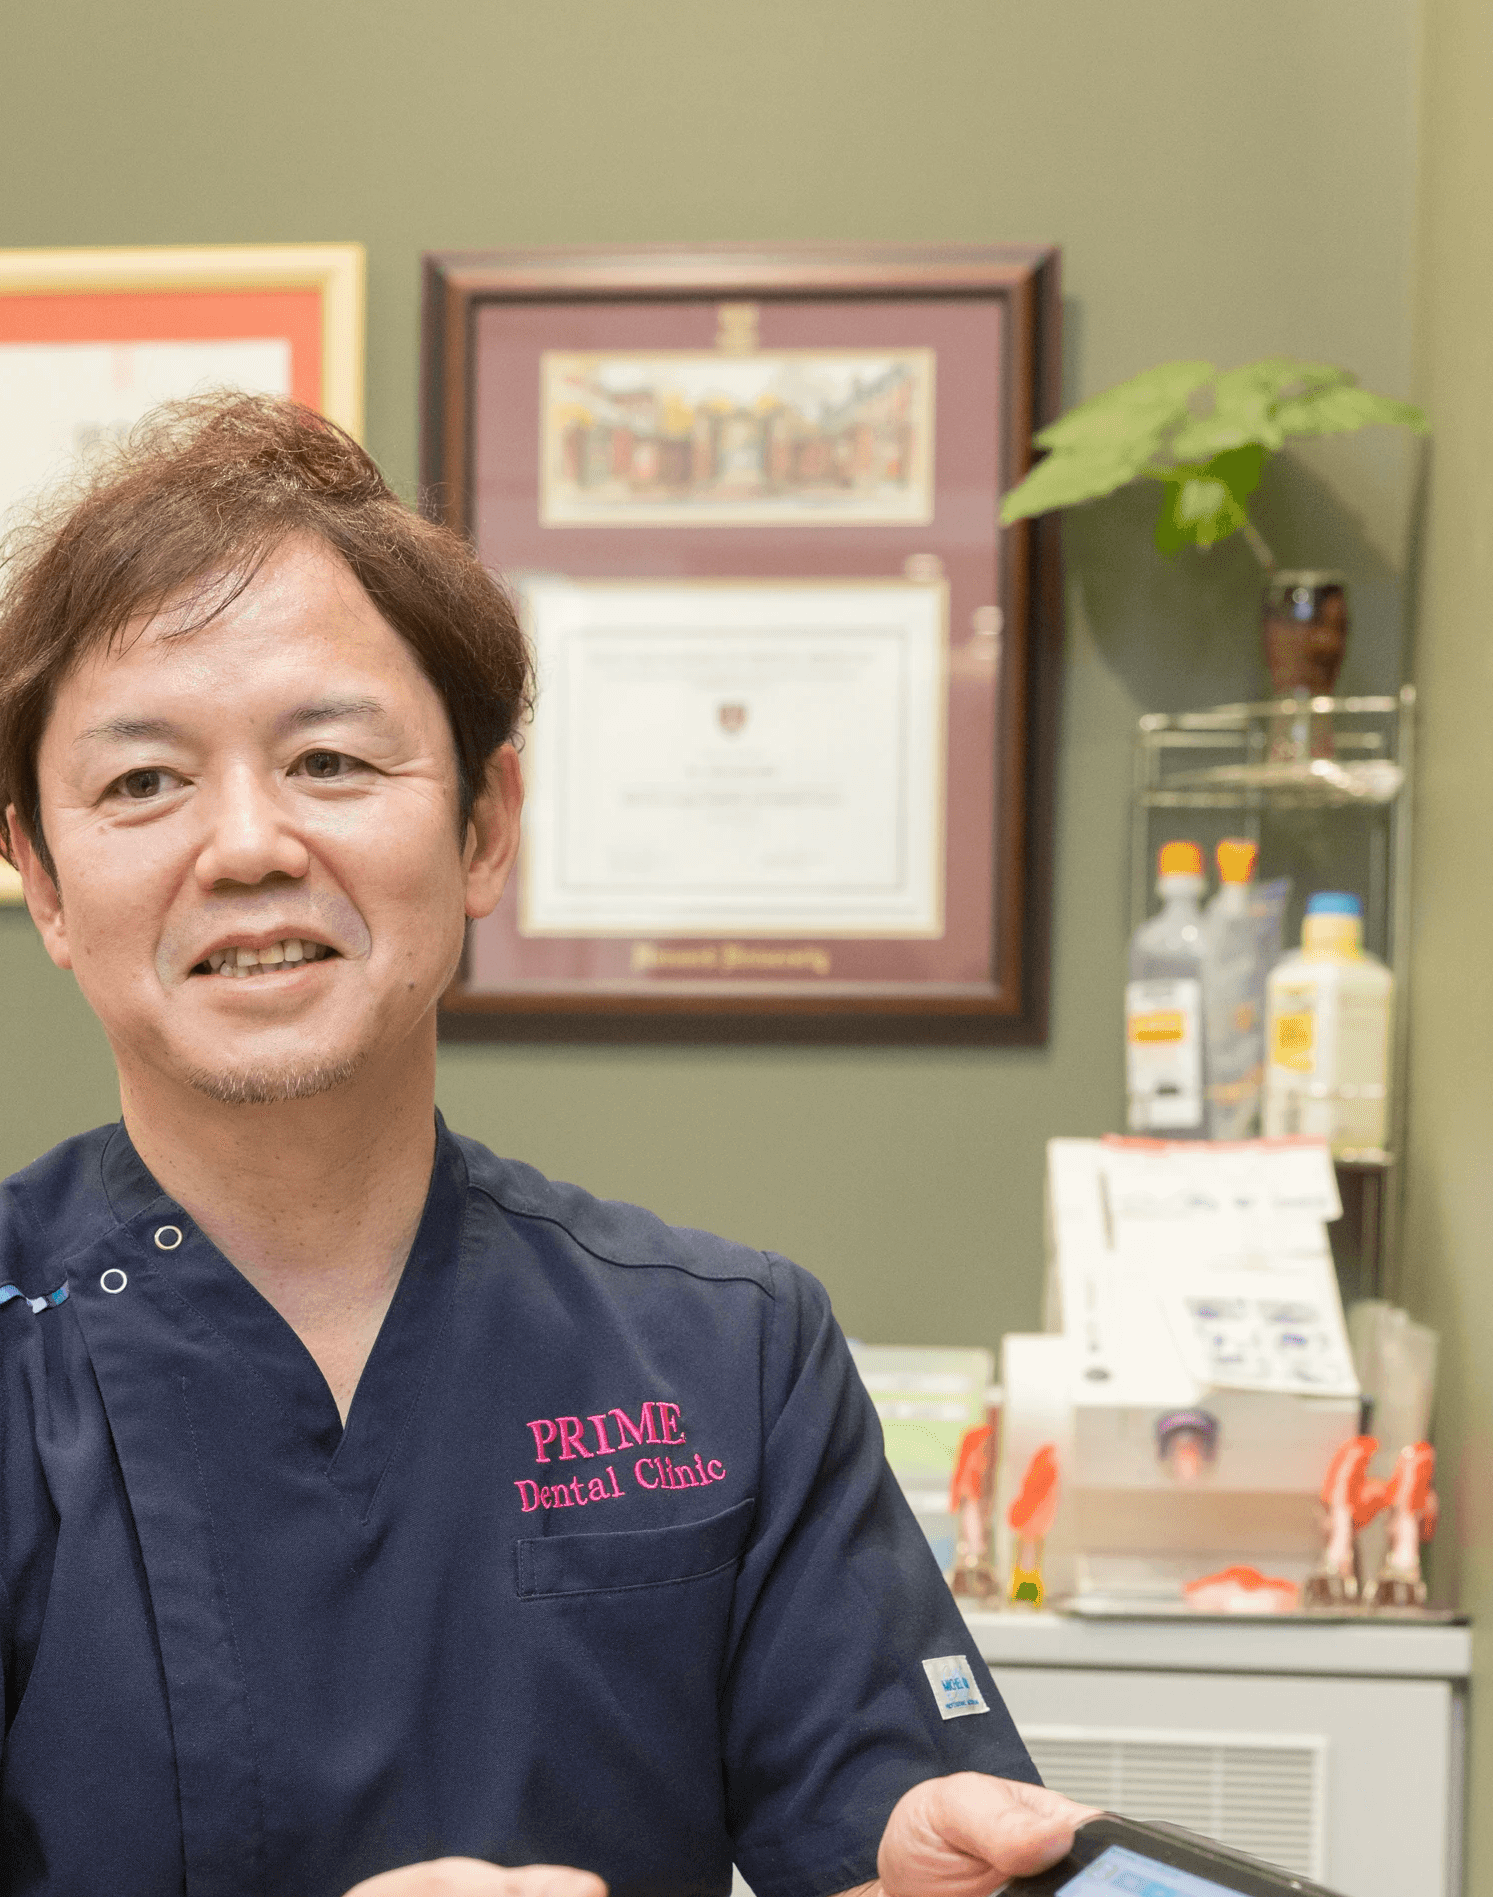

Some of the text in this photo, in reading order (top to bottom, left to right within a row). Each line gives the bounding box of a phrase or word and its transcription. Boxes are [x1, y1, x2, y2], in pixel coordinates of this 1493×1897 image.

[526, 1401, 686, 1464] PRIME
[514, 1453, 727, 1513] Dental Clinic
